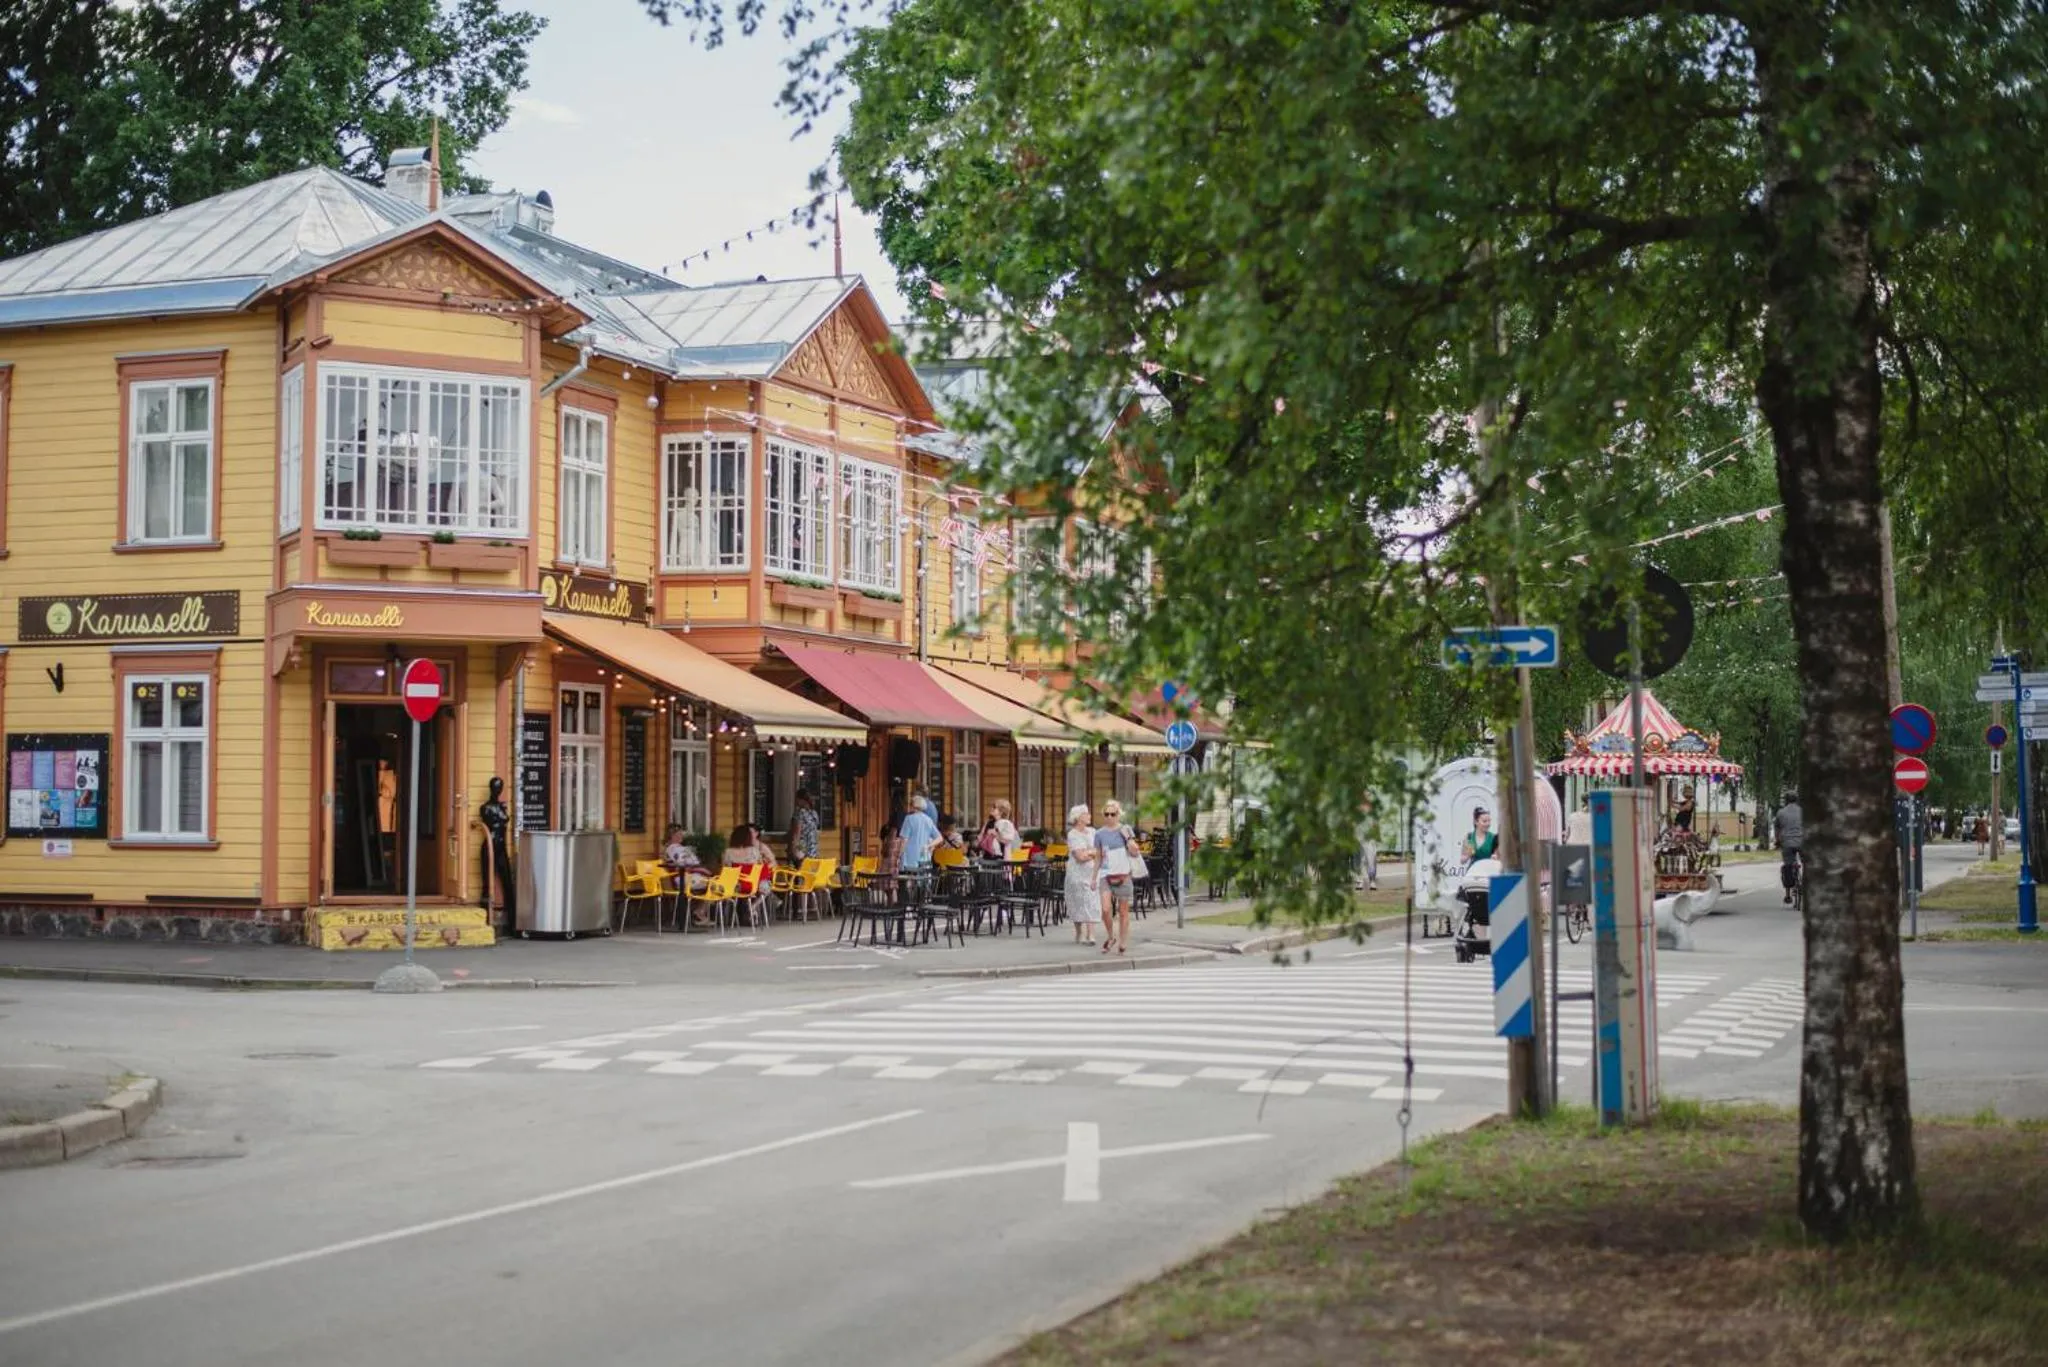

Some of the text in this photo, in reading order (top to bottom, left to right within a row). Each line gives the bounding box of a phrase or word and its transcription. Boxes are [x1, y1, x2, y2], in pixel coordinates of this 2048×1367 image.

[77, 596, 210, 635] Karusselli
[306, 602, 404, 628] Karusselli
[560, 574, 632, 618] Karusselli
